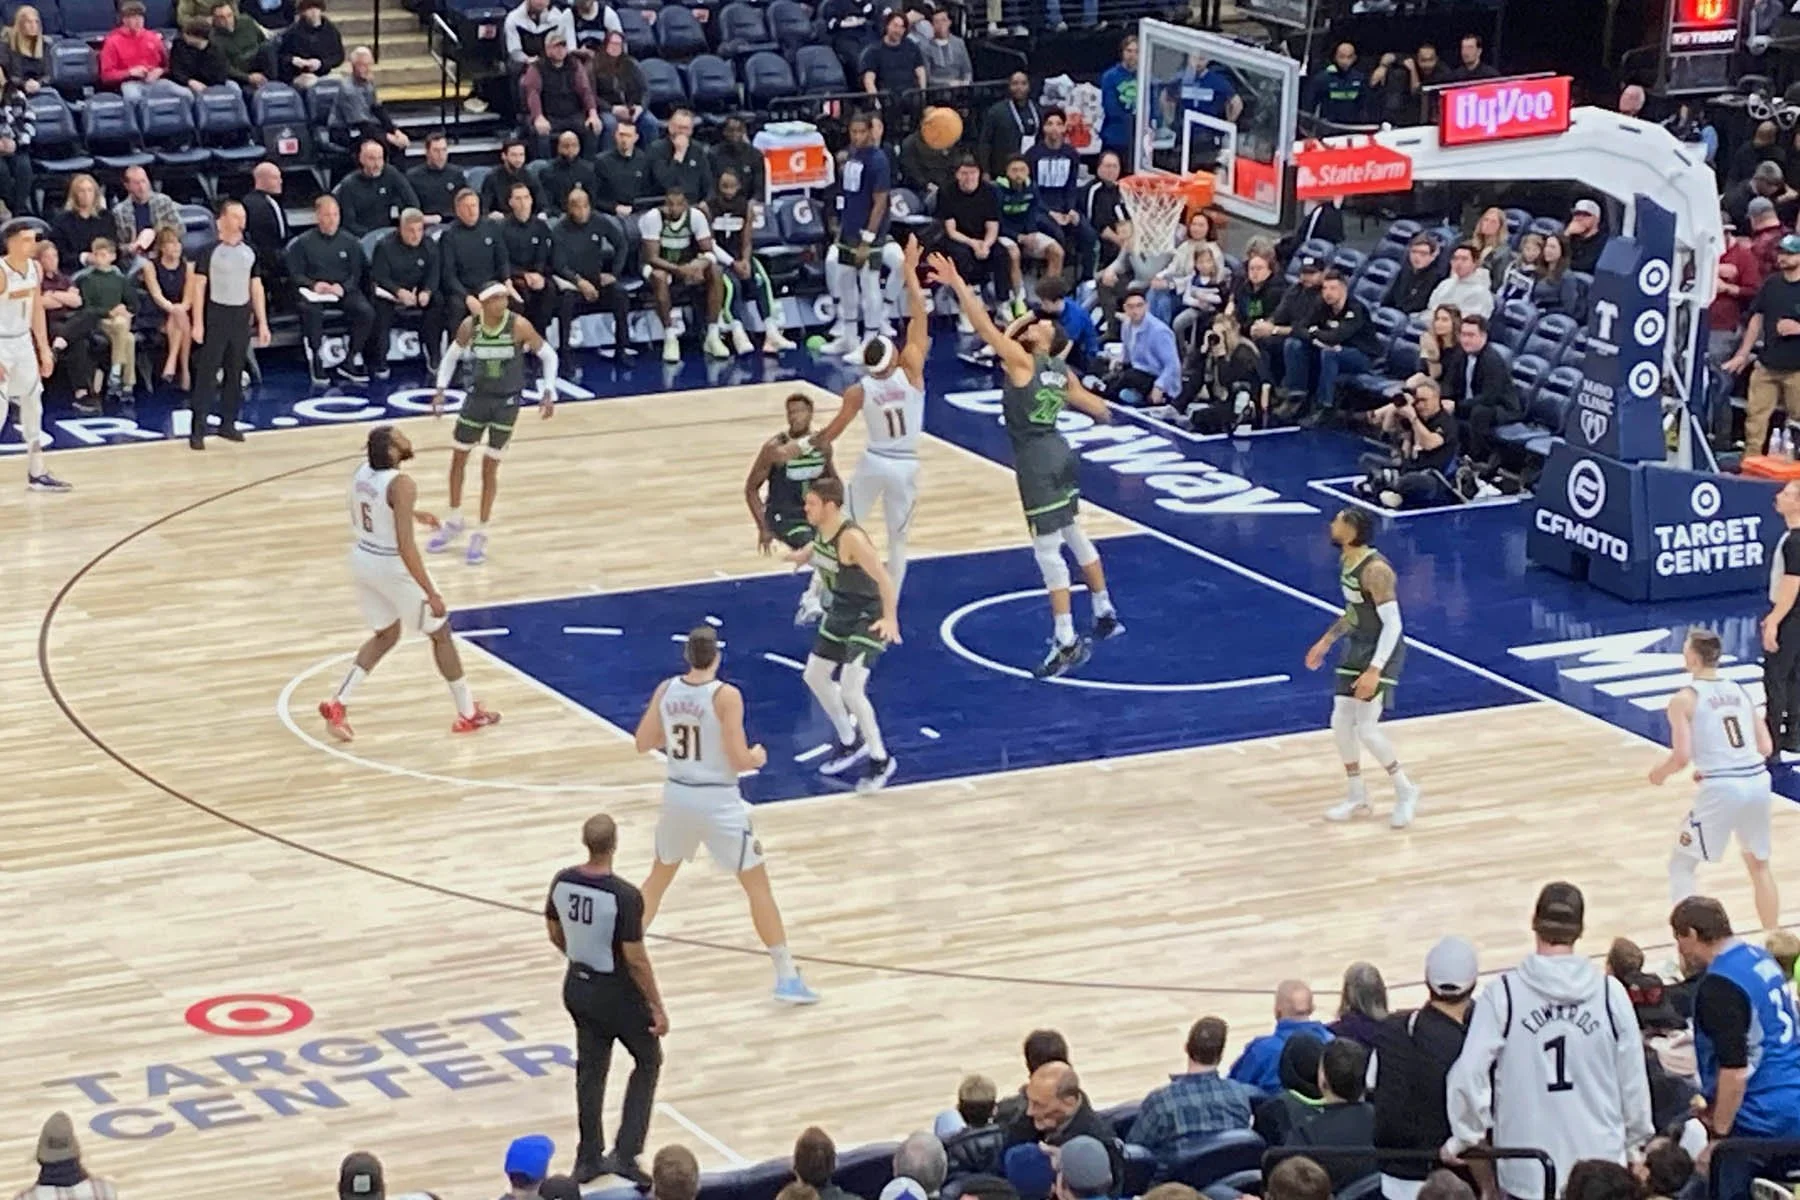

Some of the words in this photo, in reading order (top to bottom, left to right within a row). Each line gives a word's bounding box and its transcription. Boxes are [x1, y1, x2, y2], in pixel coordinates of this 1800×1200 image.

[789, 152, 807, 173] G
[793, 200, 813, 224] G
[884, 408, 906, 438] 11
[360, 502, 373, 533] 6
[1654, 516, 1761, 550] TARGET
[1535, 508, 1628, 562] CFMOTO
[1655, 542, 1764, 576] CENTER
[672, 725, 702, 761] 31
[1723, 715, 1745, 749] 0
[568, 893, 593, 925] 30
[41, 1009, 524, 1106] TARGET
[1543, 1035, 1574, 1092] 1
[87, 1042, 577, 1140] CENTER
